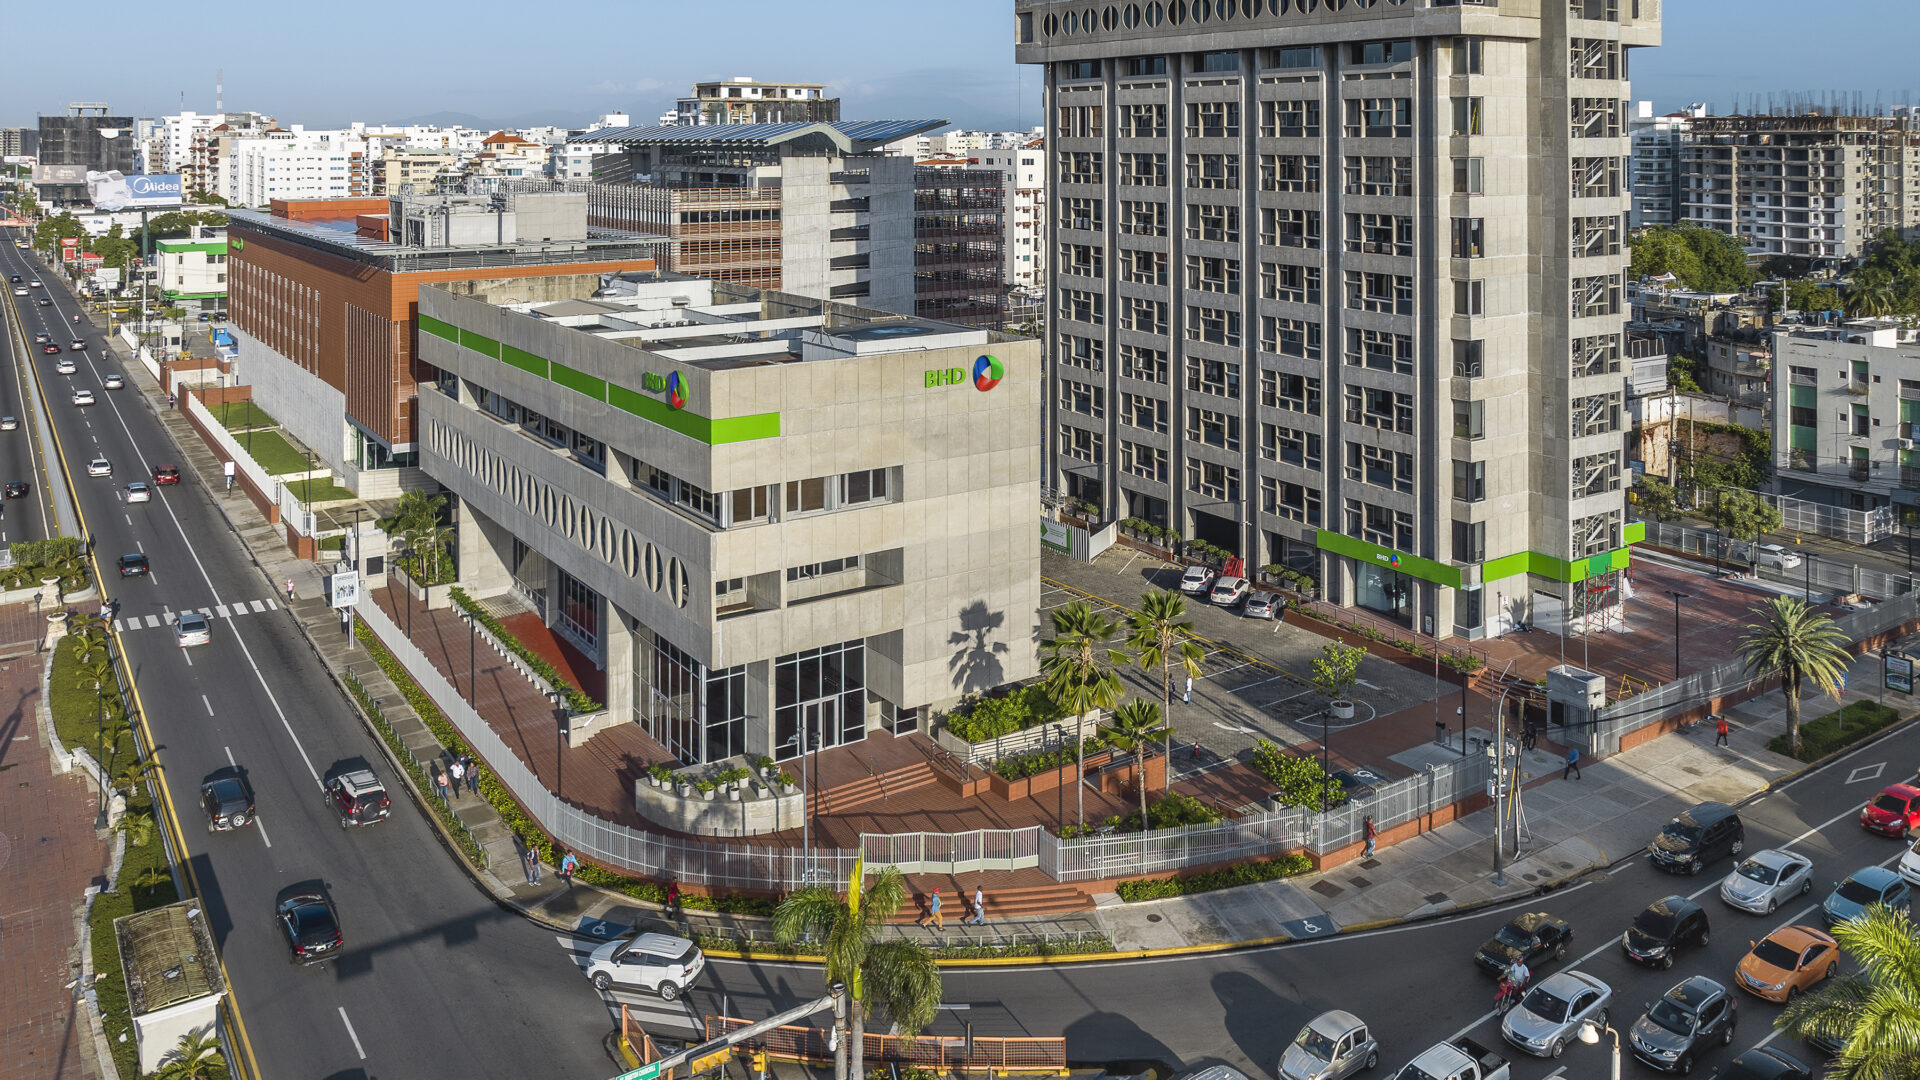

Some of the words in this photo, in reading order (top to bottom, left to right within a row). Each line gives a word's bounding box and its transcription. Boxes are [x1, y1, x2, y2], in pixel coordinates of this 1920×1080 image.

[138, 180, 179, 192] Midea
[645, 370, 666, 392] BHD
[925, 367, 967, 388] BHD
[1376, 553, 1388, 561] BHD
